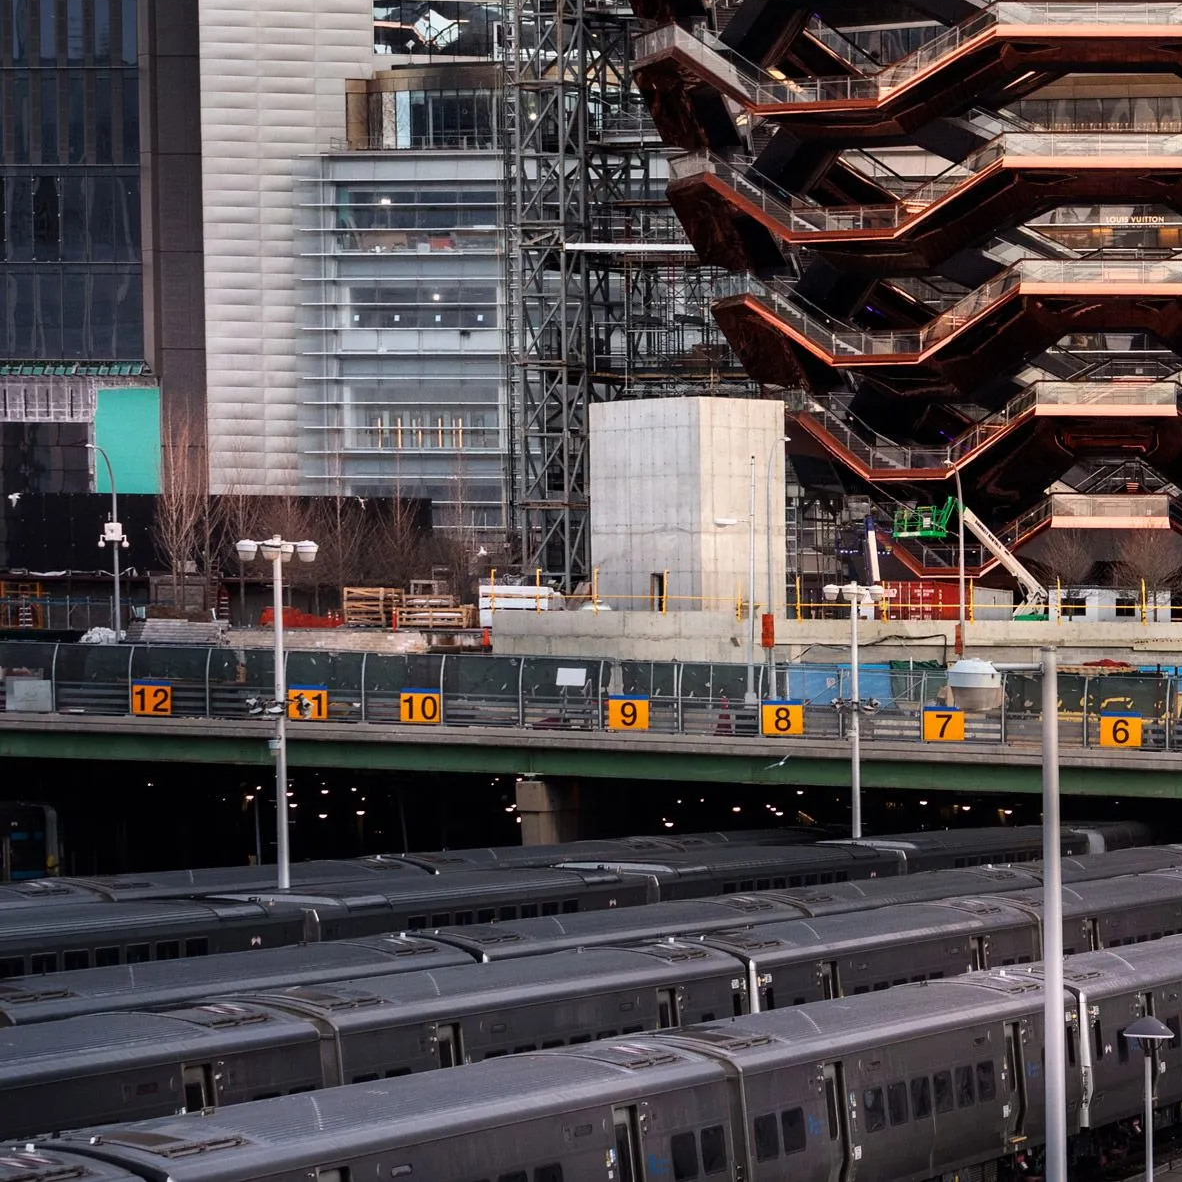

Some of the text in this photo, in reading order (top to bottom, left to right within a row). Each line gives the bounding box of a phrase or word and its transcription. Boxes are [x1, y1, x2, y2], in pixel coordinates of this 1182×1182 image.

[136, 688, 168, 711] 12
[404, 696, 437, 720] 10
[621, 703, 637, 726] 9
[775, 708, 791, 731] 8
[936, 714, 952, 737] 7
[1113, 720, 1129, 743] 6
